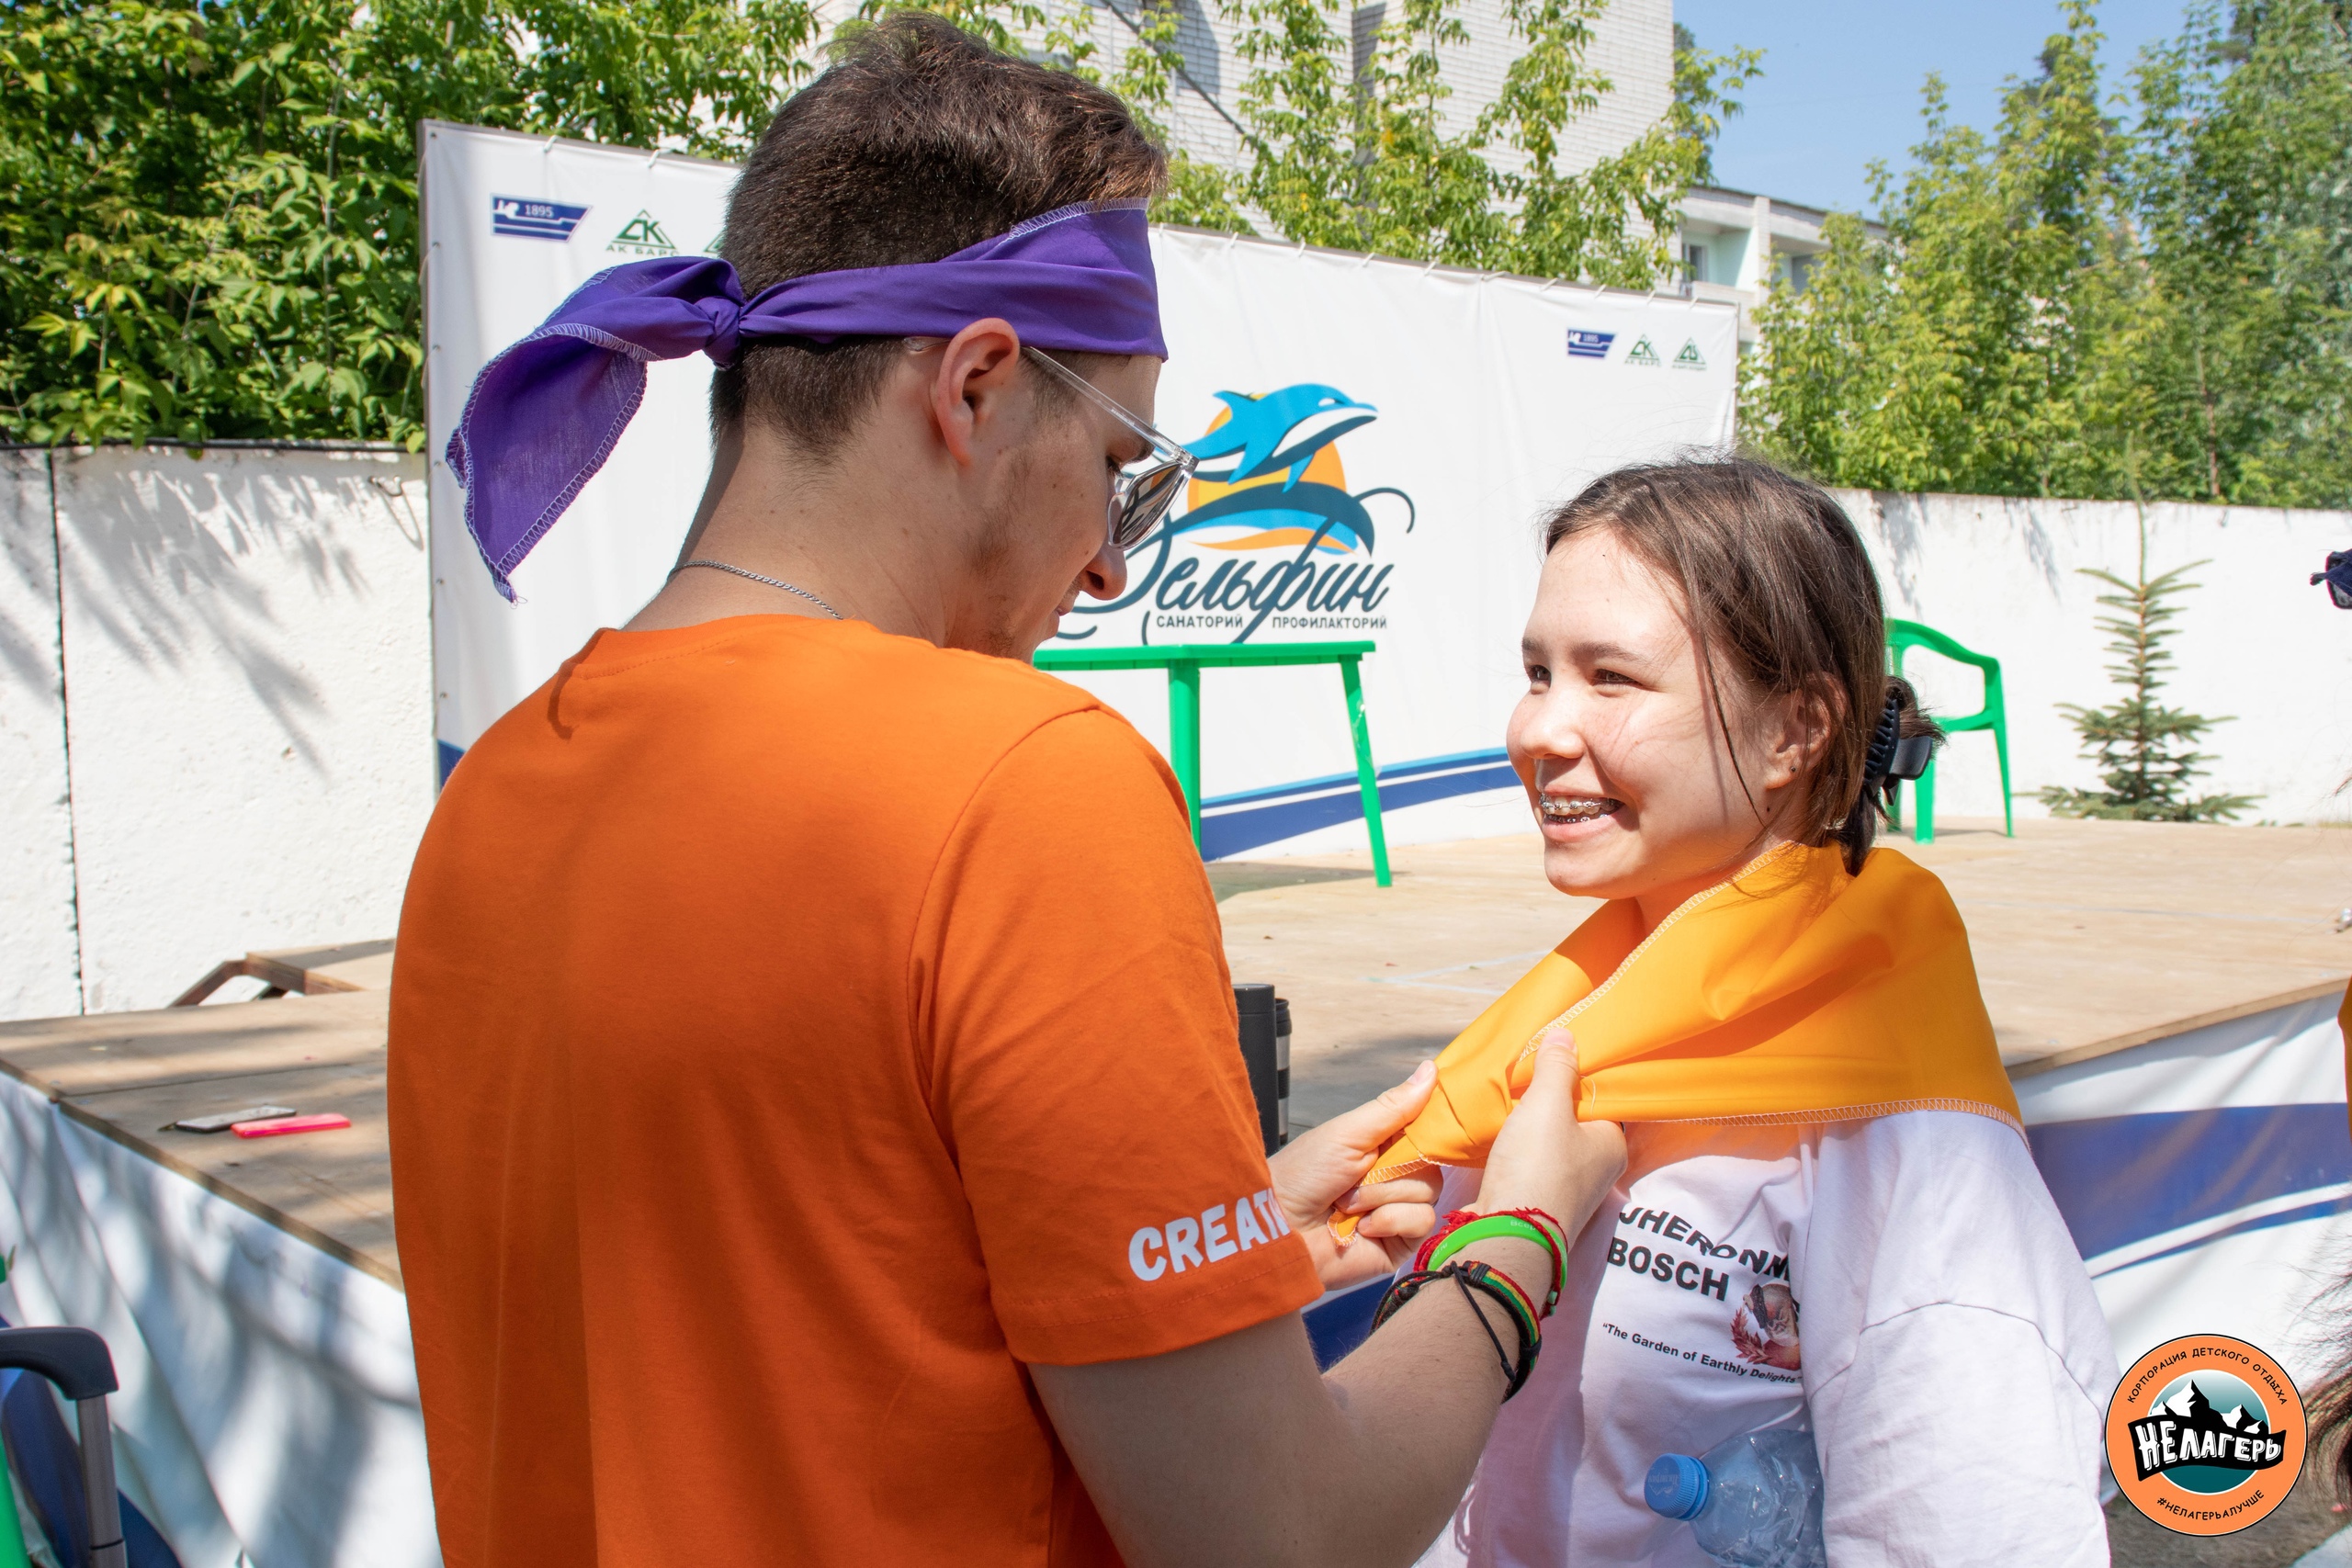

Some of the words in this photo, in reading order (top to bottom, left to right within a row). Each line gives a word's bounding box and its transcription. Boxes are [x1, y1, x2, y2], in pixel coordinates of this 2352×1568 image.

[525, 204, 554, 219] 1895
[1157, 614, 1243, 628] САНАТОРИЙ
[1272, 615, 1387, 629] ПРОФИЛАКТОРИЙ
[1128, 1188, 1290, 1281] CREATI
[1607, 1236, 1729, 1302] BOSCH
[1632, 1333, 1679, 1357] Garden
[1682, 1351, 1697, 1361] of
[1700, 1355, 1747, 1376] Earthly
